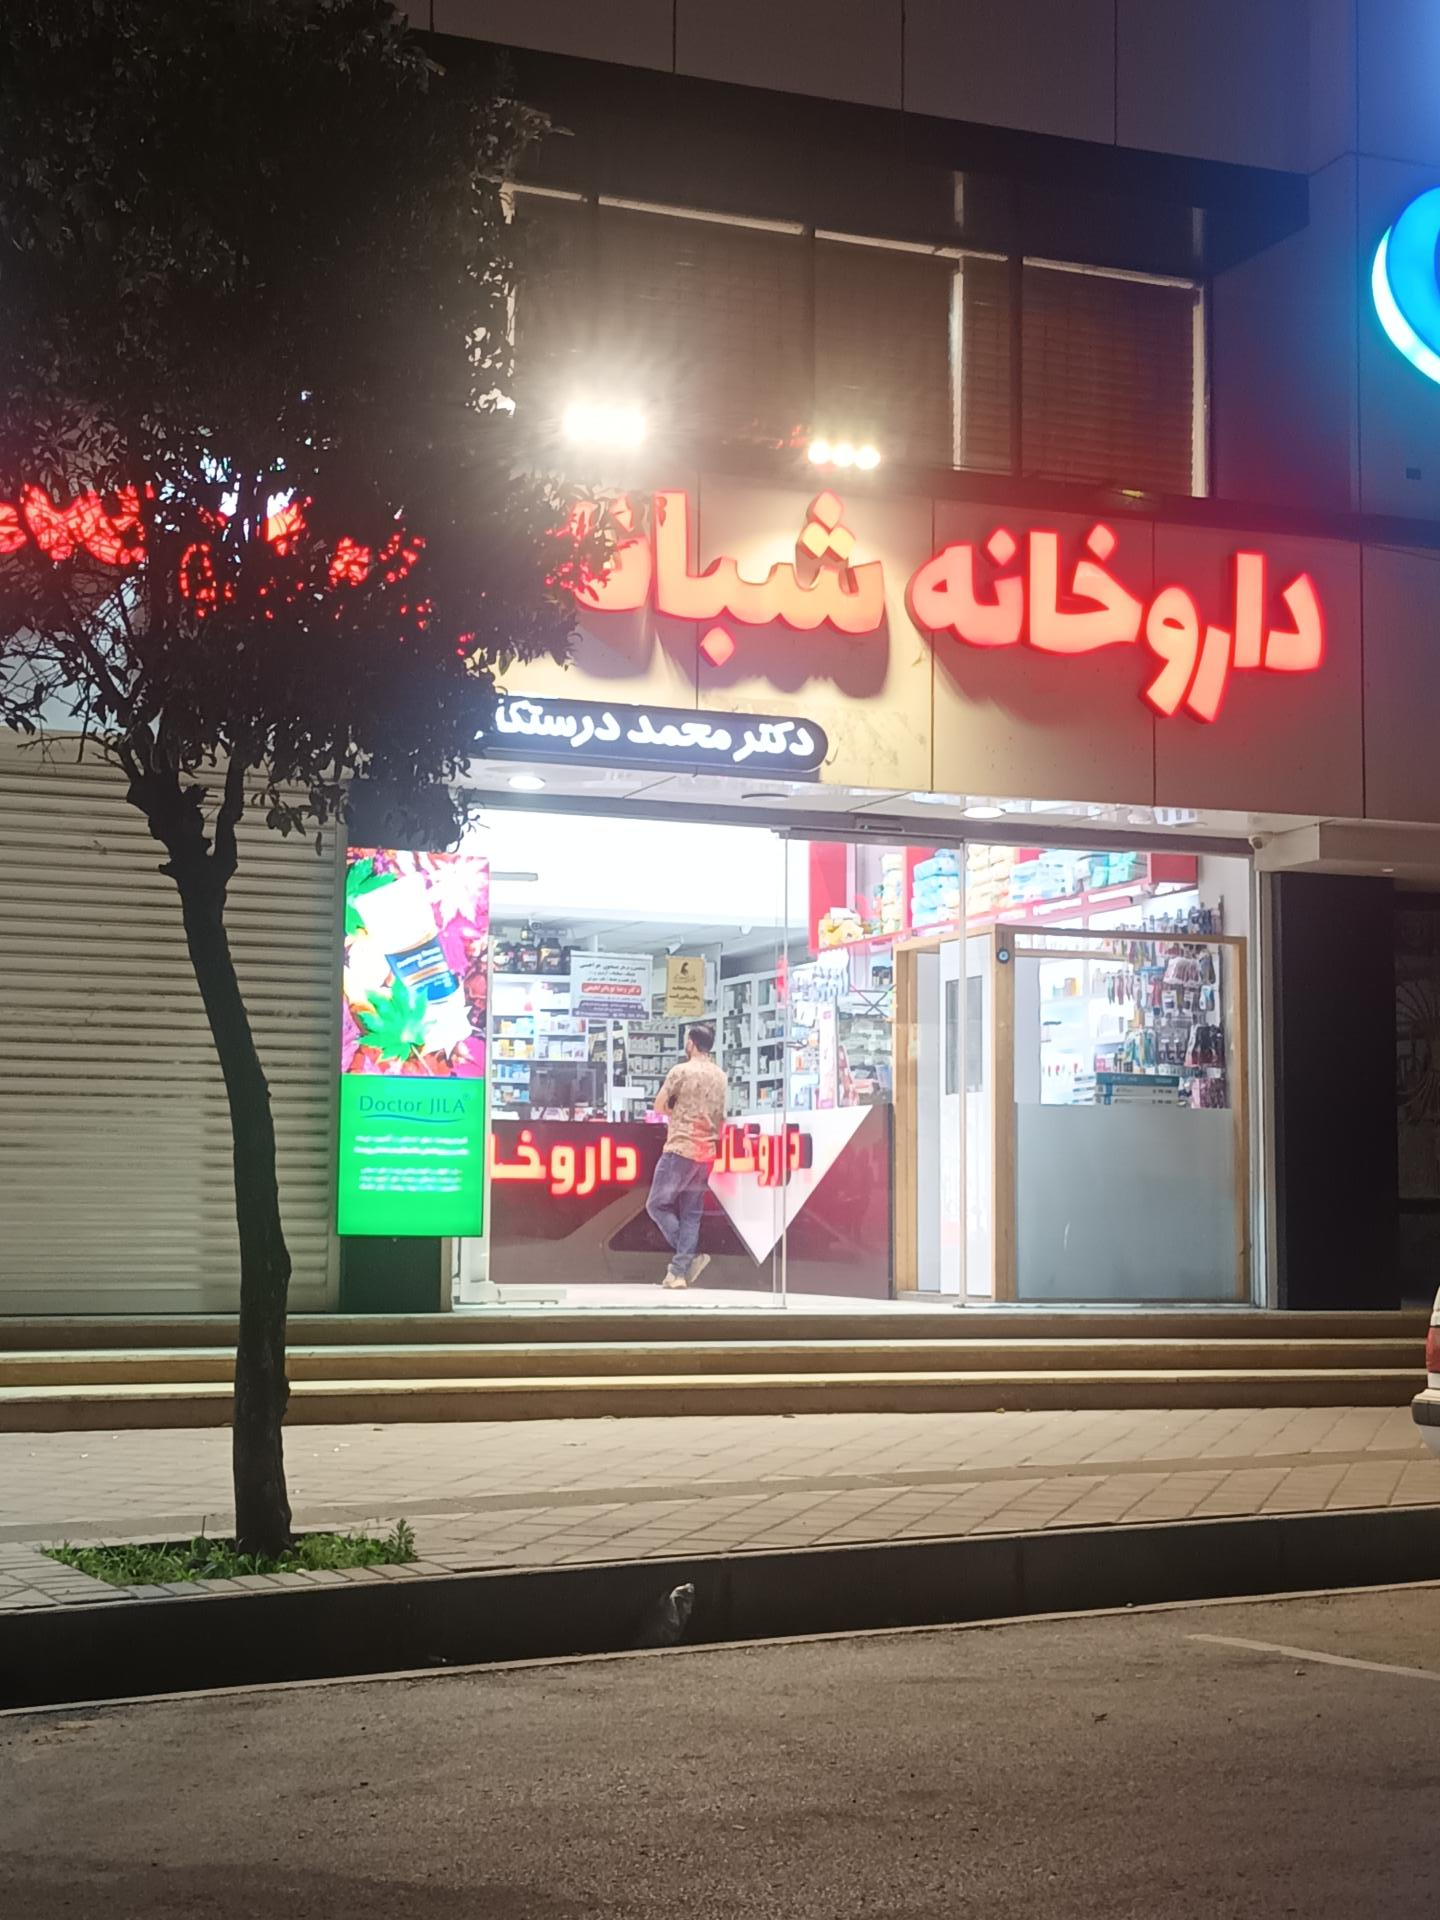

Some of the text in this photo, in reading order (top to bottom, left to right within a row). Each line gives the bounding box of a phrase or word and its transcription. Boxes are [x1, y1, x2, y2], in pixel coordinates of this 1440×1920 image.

[908, 524, 1324, 722] داروخانه
[626, 715, 732, 751] محمد
[733, 721, 815, 763] دکتر
[359, 1095, 423, 1113] Doctor
